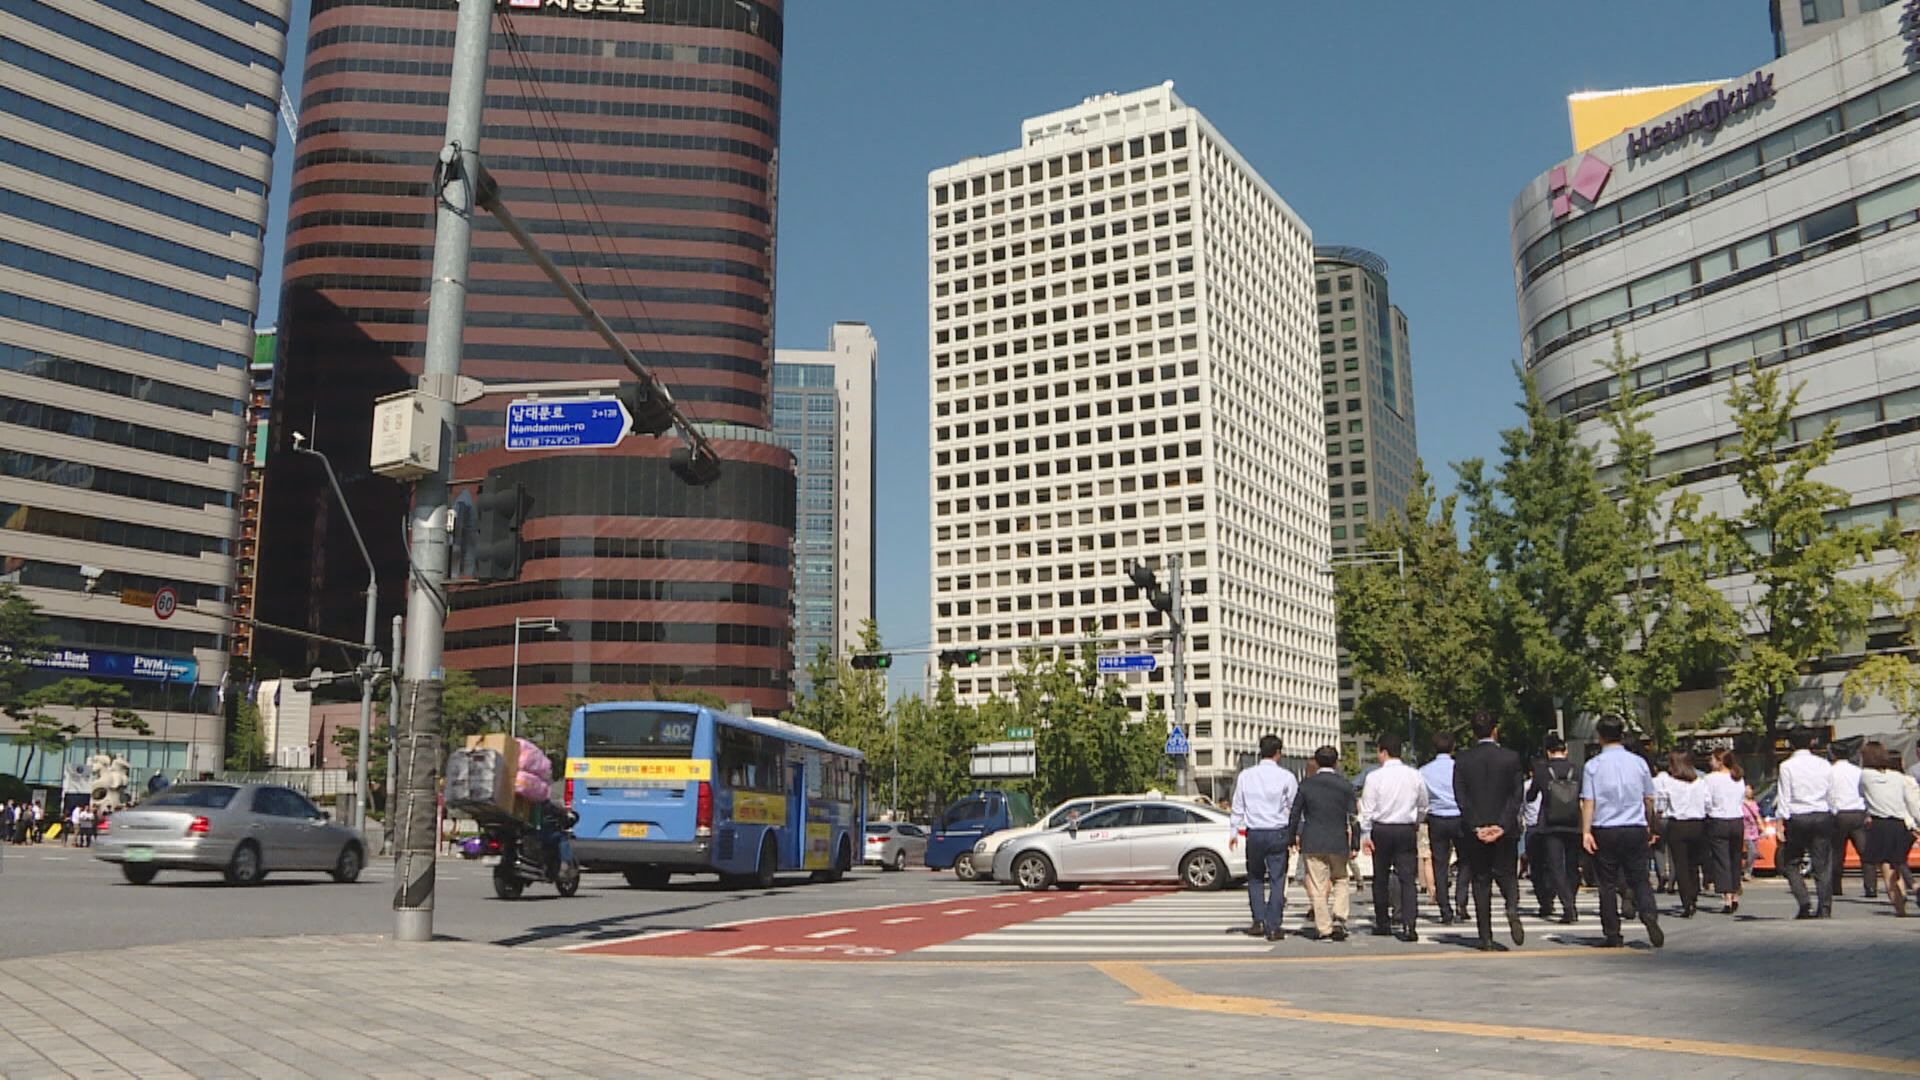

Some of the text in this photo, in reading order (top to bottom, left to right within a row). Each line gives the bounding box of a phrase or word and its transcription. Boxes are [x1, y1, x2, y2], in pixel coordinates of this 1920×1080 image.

[1627, 71, 1777, 158] Heungkuk
[511, 405, 565, 422] 남대문로
[511, 423, 586, 435] Namdaemun-ro
[158, 595, 173, 611] 60
[134, 656, 165, 669] PWM
[663, 723, 692, 740] 402
